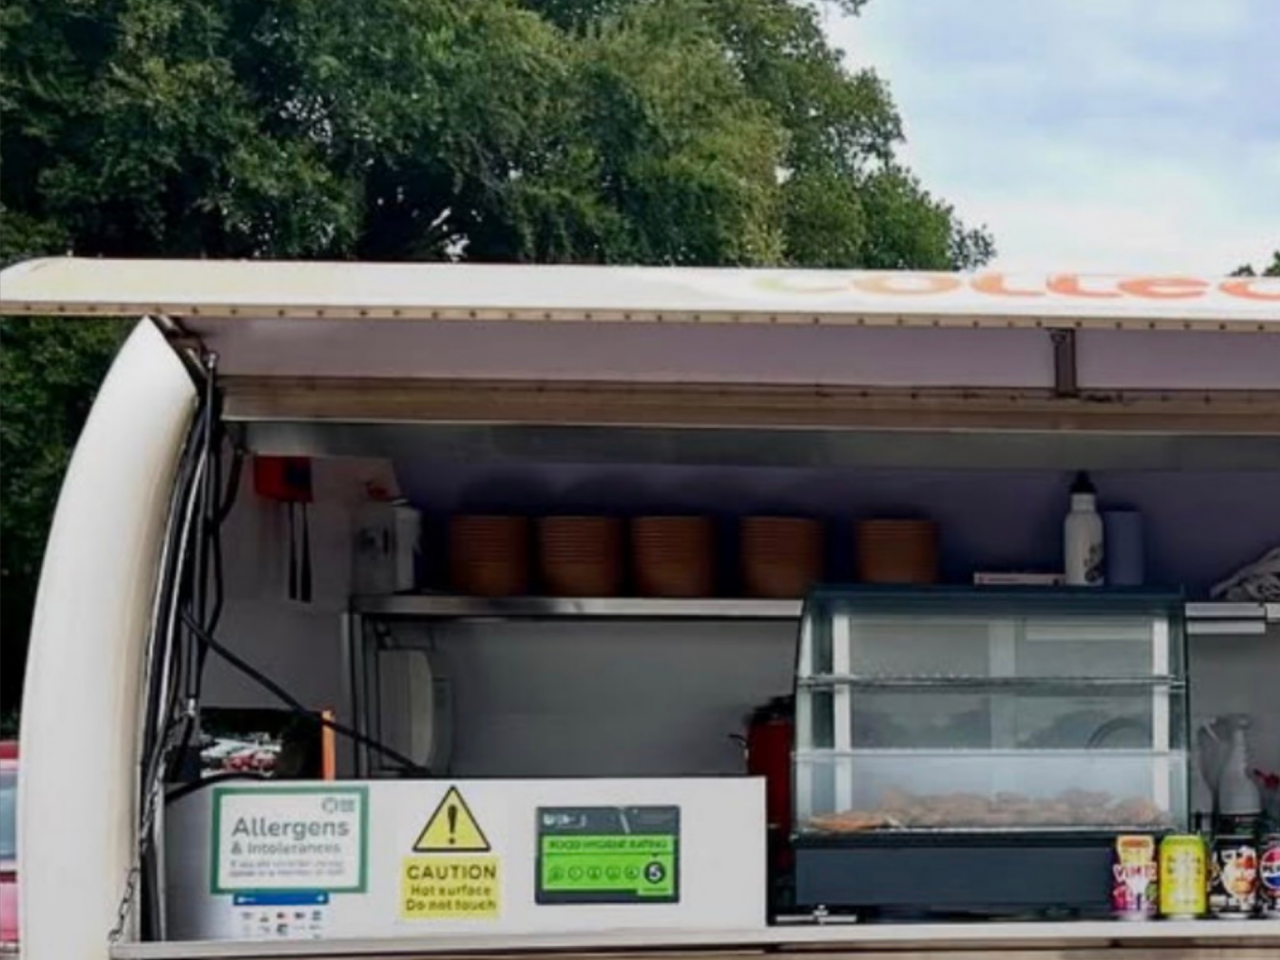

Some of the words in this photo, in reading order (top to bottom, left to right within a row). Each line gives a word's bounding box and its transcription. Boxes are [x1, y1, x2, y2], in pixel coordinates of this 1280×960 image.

[231, 817, 350, 841] Allergens
[231, 841, 242, 854] &
[406, 864, 496, 880] CAUTION
[648, 865, 662, 881] 5
[411, 884, 434, 896] Hot
[439, 883, 491, 896] surface
[406, 898, 426, 911] Do
[428, 899, 452, 911] not
[455, 898, 497, 911] touch
